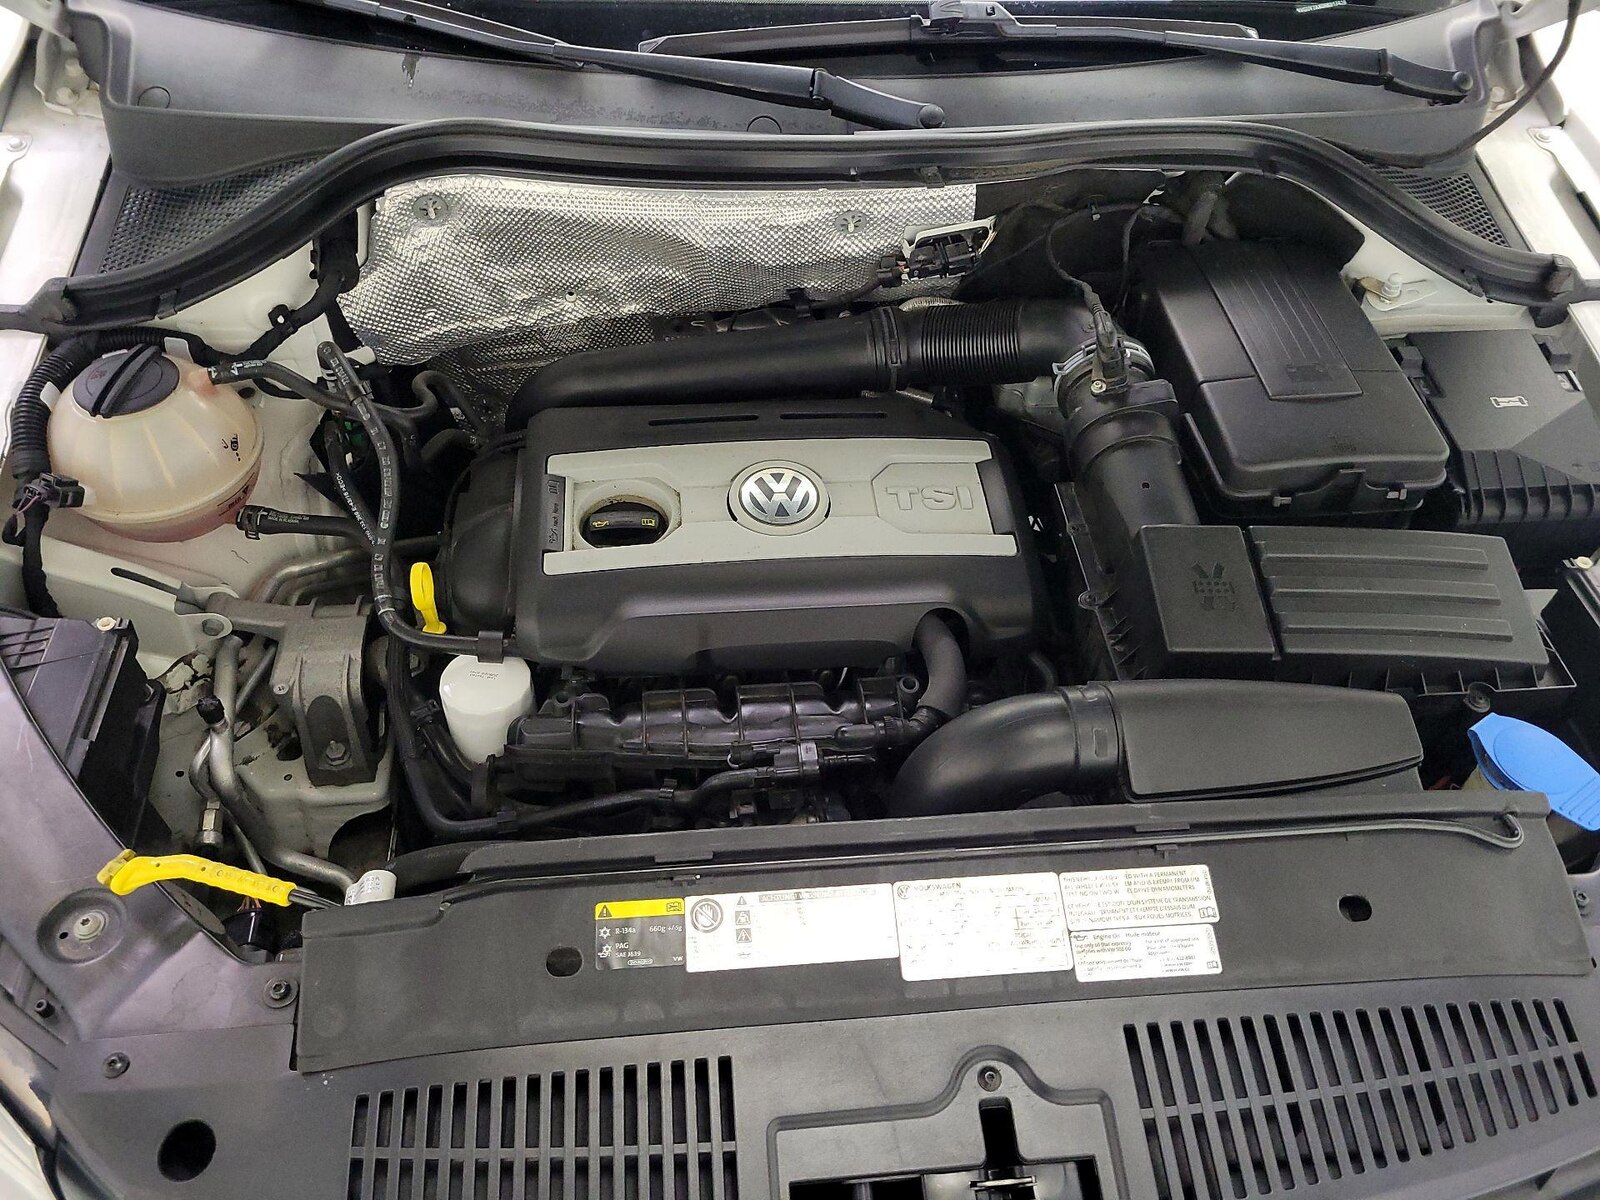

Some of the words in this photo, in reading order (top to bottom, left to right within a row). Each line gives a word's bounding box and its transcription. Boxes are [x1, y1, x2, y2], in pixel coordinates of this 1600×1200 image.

[887, 484, 976, 513] TSI
[615, 927, 636, 935] R-134a
[649, 925, 666, 933] 660g
